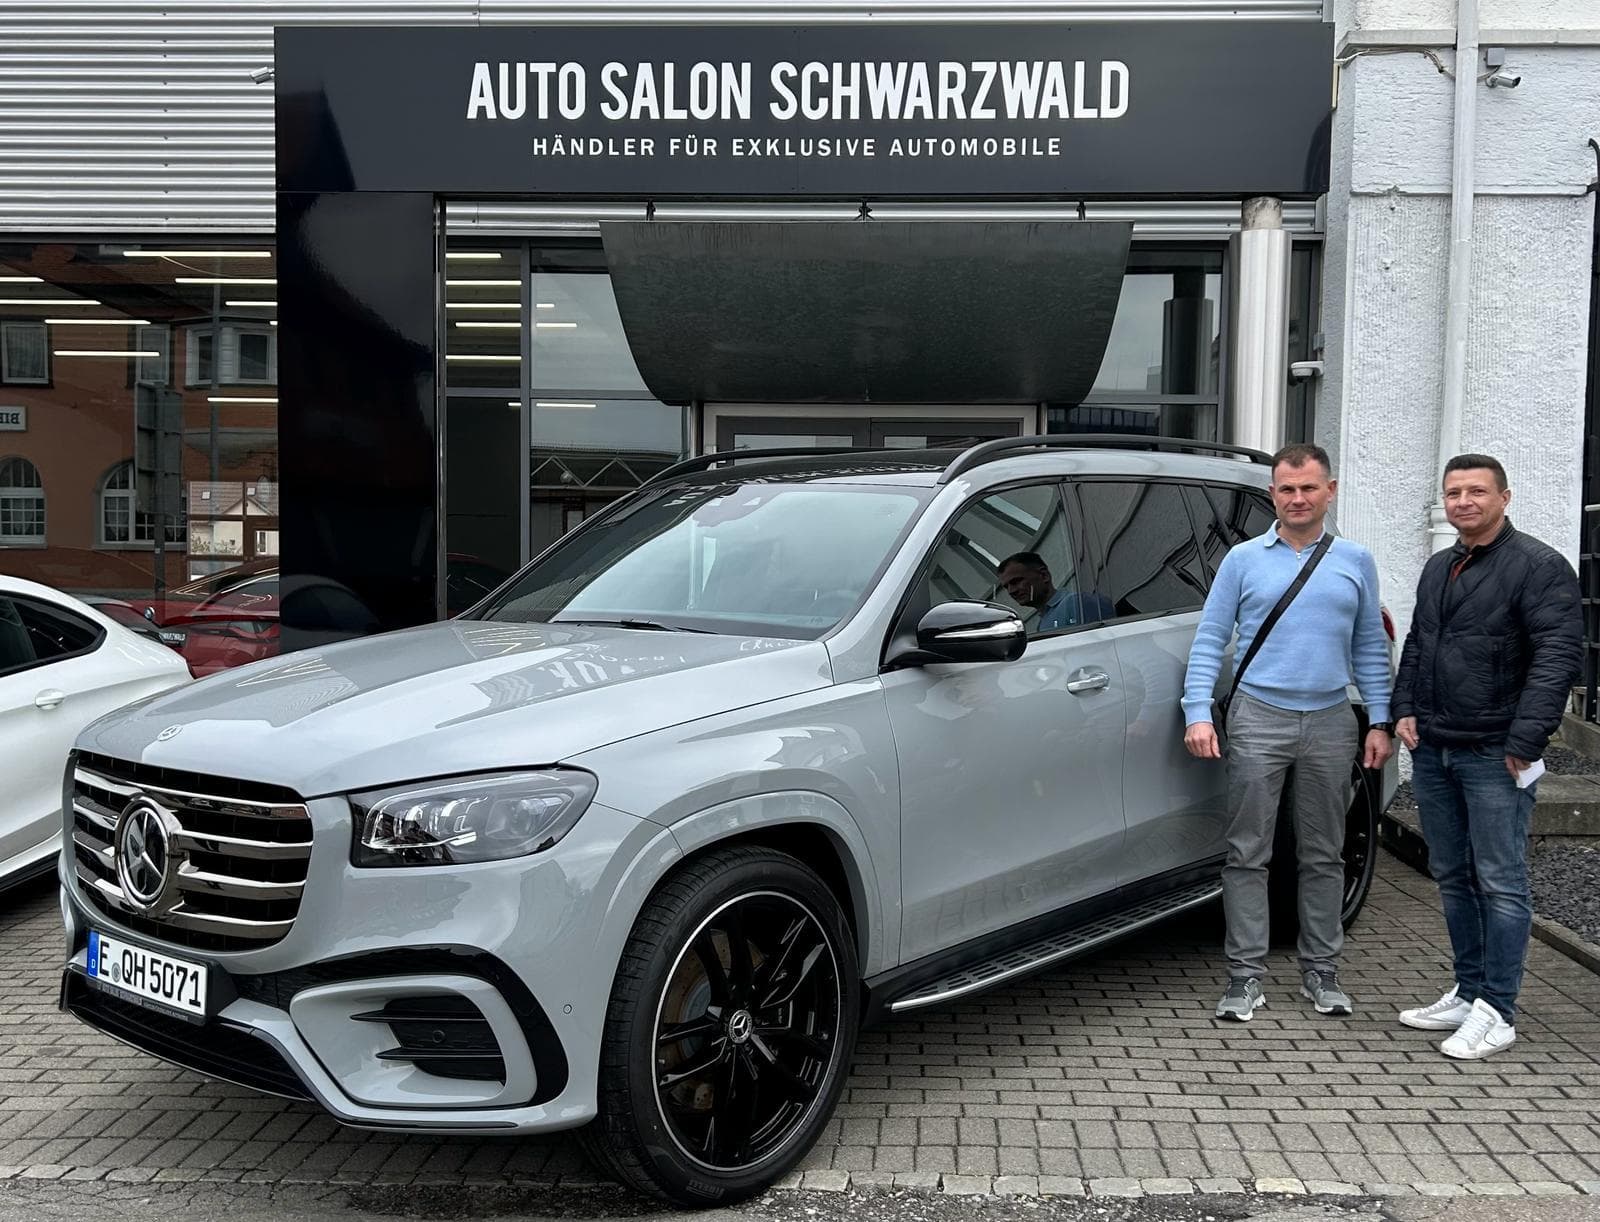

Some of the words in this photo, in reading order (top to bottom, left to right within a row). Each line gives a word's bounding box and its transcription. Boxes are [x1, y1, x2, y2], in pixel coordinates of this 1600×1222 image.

[467, 61, 586, 120] AUTO
[601, 61, 752, 121] SALON
[770, 60, 1130, 121] SCHWARZWALD
[533, 134, 655, 156] HÄNDLER
[669, 134, 717, 156] FÜR
[732, 138, 876, 157] EXKLUSIVE
[888, 138, 1061, 157] AUTOMOBILE
[100, 941, 110, 976] E
